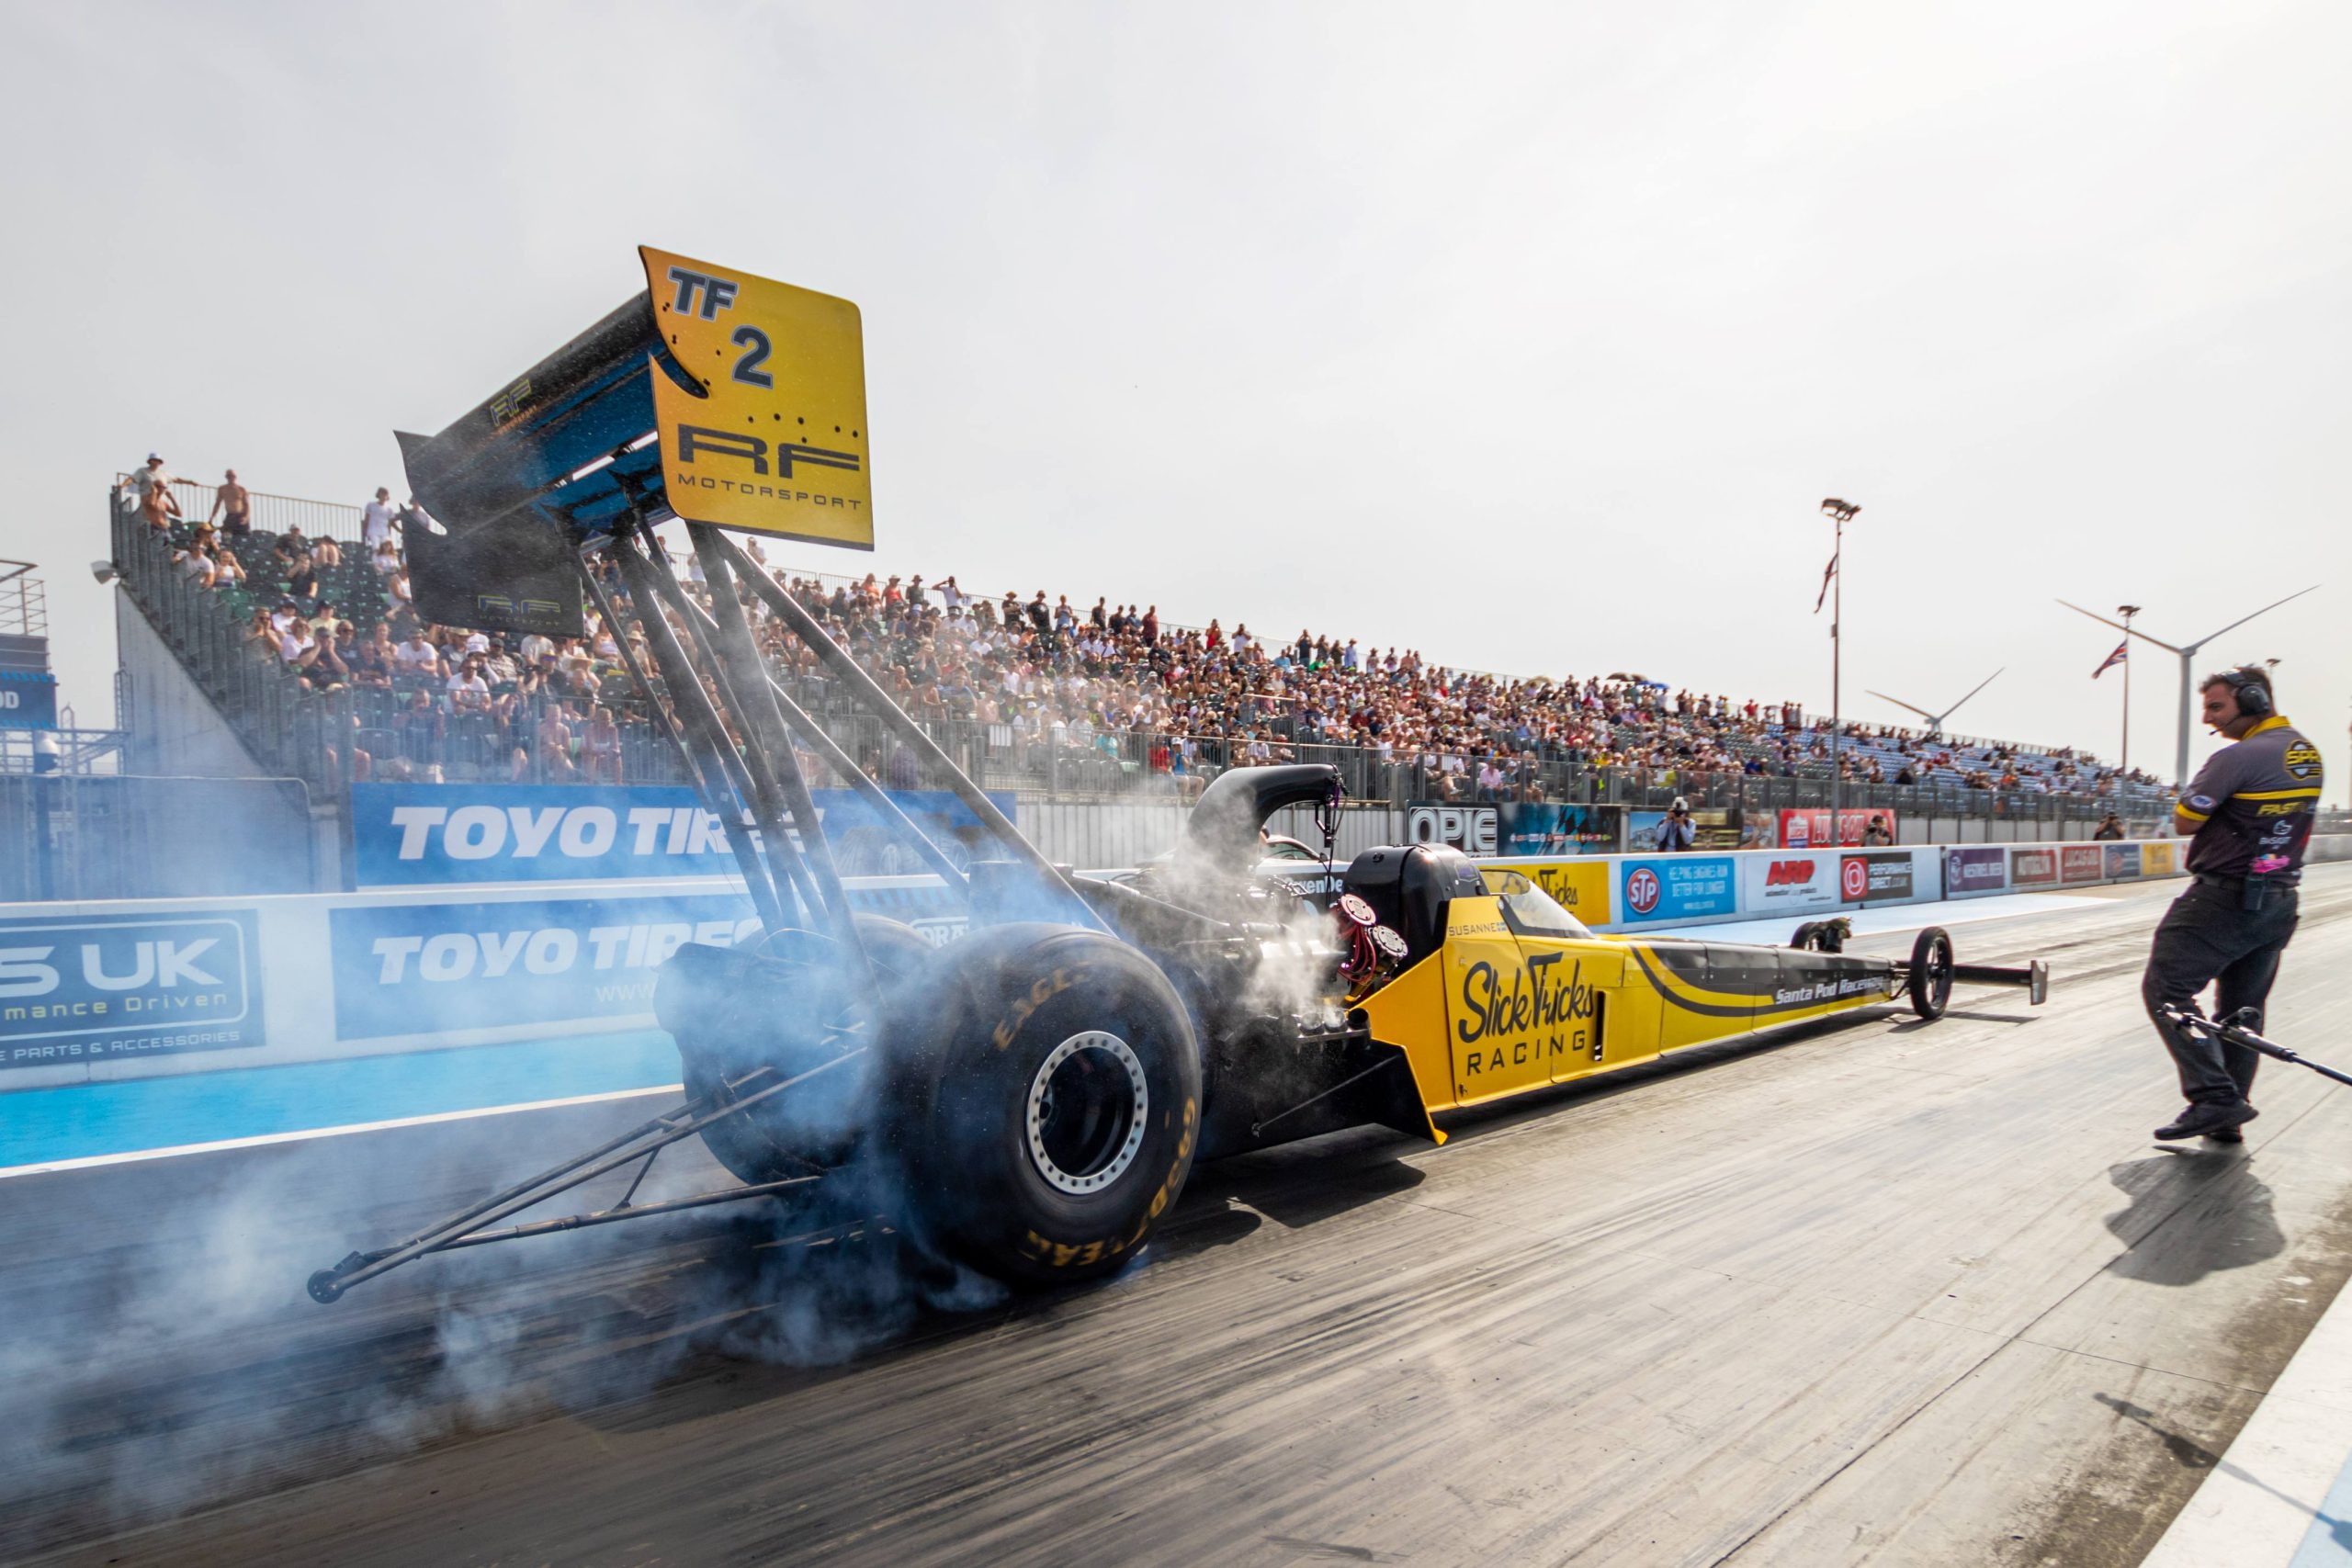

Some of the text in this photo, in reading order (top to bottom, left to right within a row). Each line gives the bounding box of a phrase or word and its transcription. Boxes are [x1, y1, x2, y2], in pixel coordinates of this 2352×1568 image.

[668, 266, 738, 321] TF
[730, 325, 774, 390] 2
[490, 379, 531, 426] RF
[677, 423, 860, 479] RF
[678, 474, 861, 510] MOTORSPORT
[391, 806, 617, 860] TOYO
[1410, 808, 1497, 852] OPIE
[1631, 874, 1657, 907] STP
[1765, 860, 1815, 886] ARP
[1449, 922, 1498, 936] SUSANNE
[81, 938, 224, 990] UK
[372, 928, 578, 985] TOYO
[5, 993, 228, 1021] mance Driven
[1459, 952, 1594, 1043] Slick Tricks
[1775, 976, 1885, 1005] Santa Pod Raceway
[15, 1043, 83, 1061] PARTS
[89, 1042, 104, 1054] &
[111, 1030, 241, 1053] ACCESSORIES
[1467, 1030, 1586, 1076] RACING
